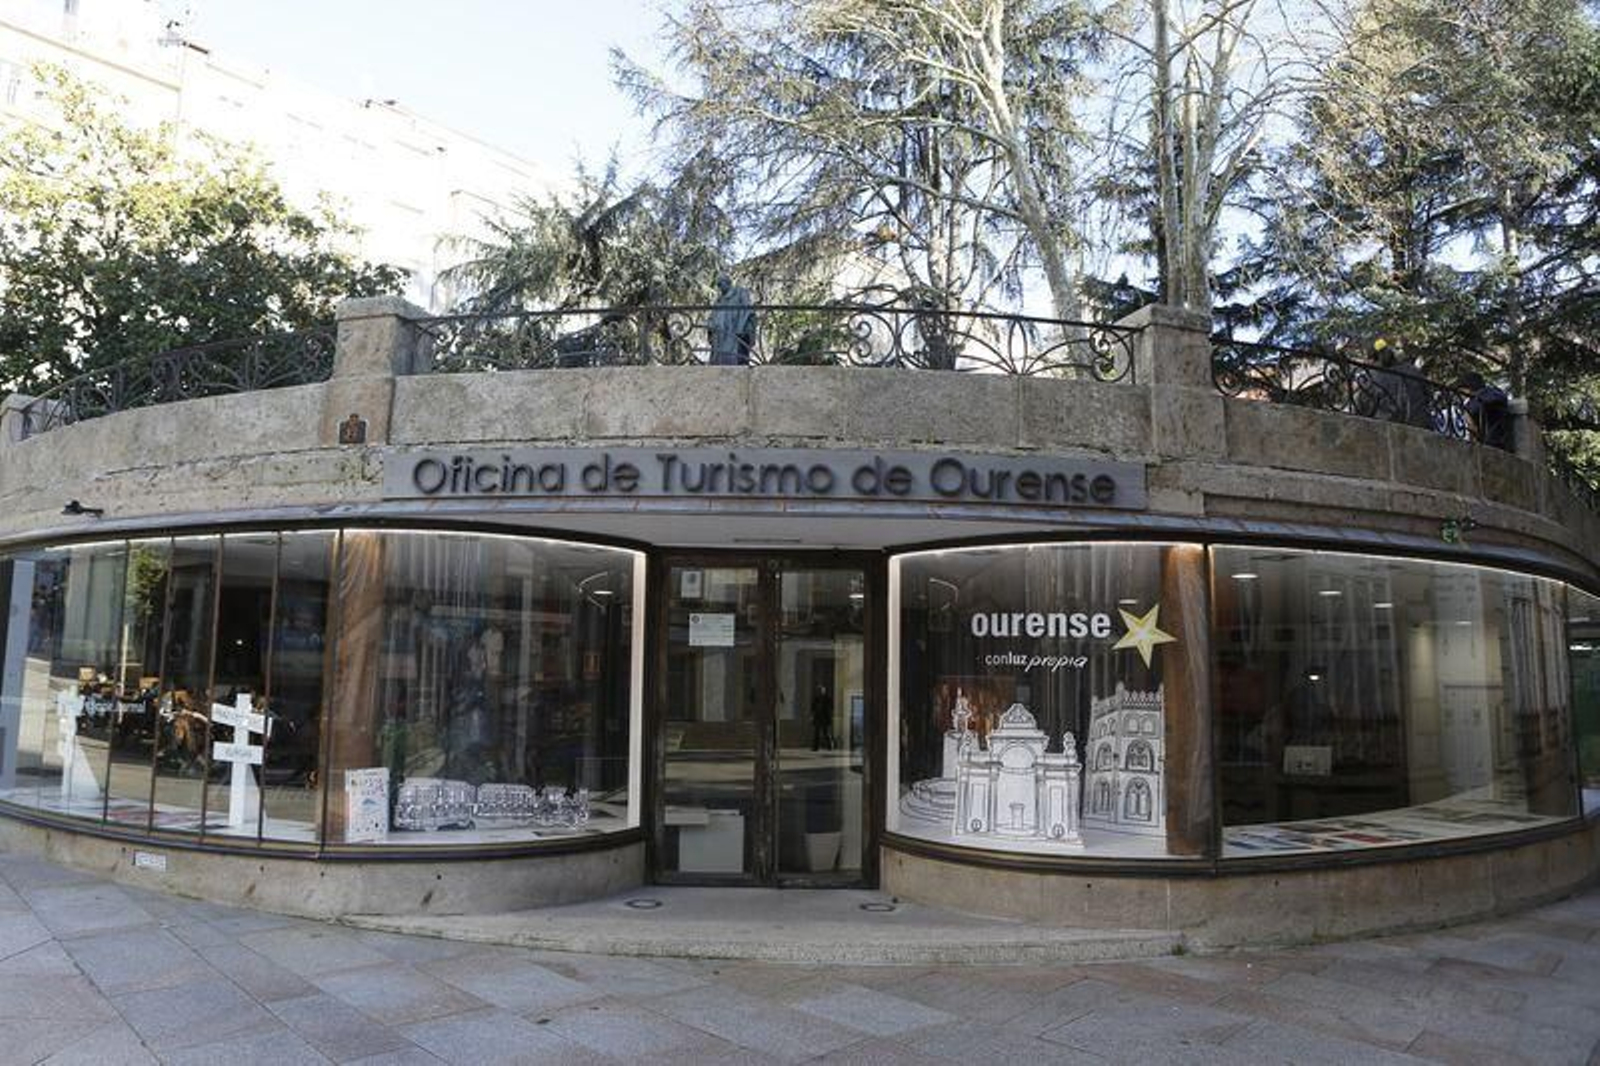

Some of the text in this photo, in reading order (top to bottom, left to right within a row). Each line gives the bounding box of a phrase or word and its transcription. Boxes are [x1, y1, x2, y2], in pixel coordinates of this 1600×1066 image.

[412, 452, 1117, 501] Oficina de Turismo de Ourense
[971, 612, 1112, 638] ourense
